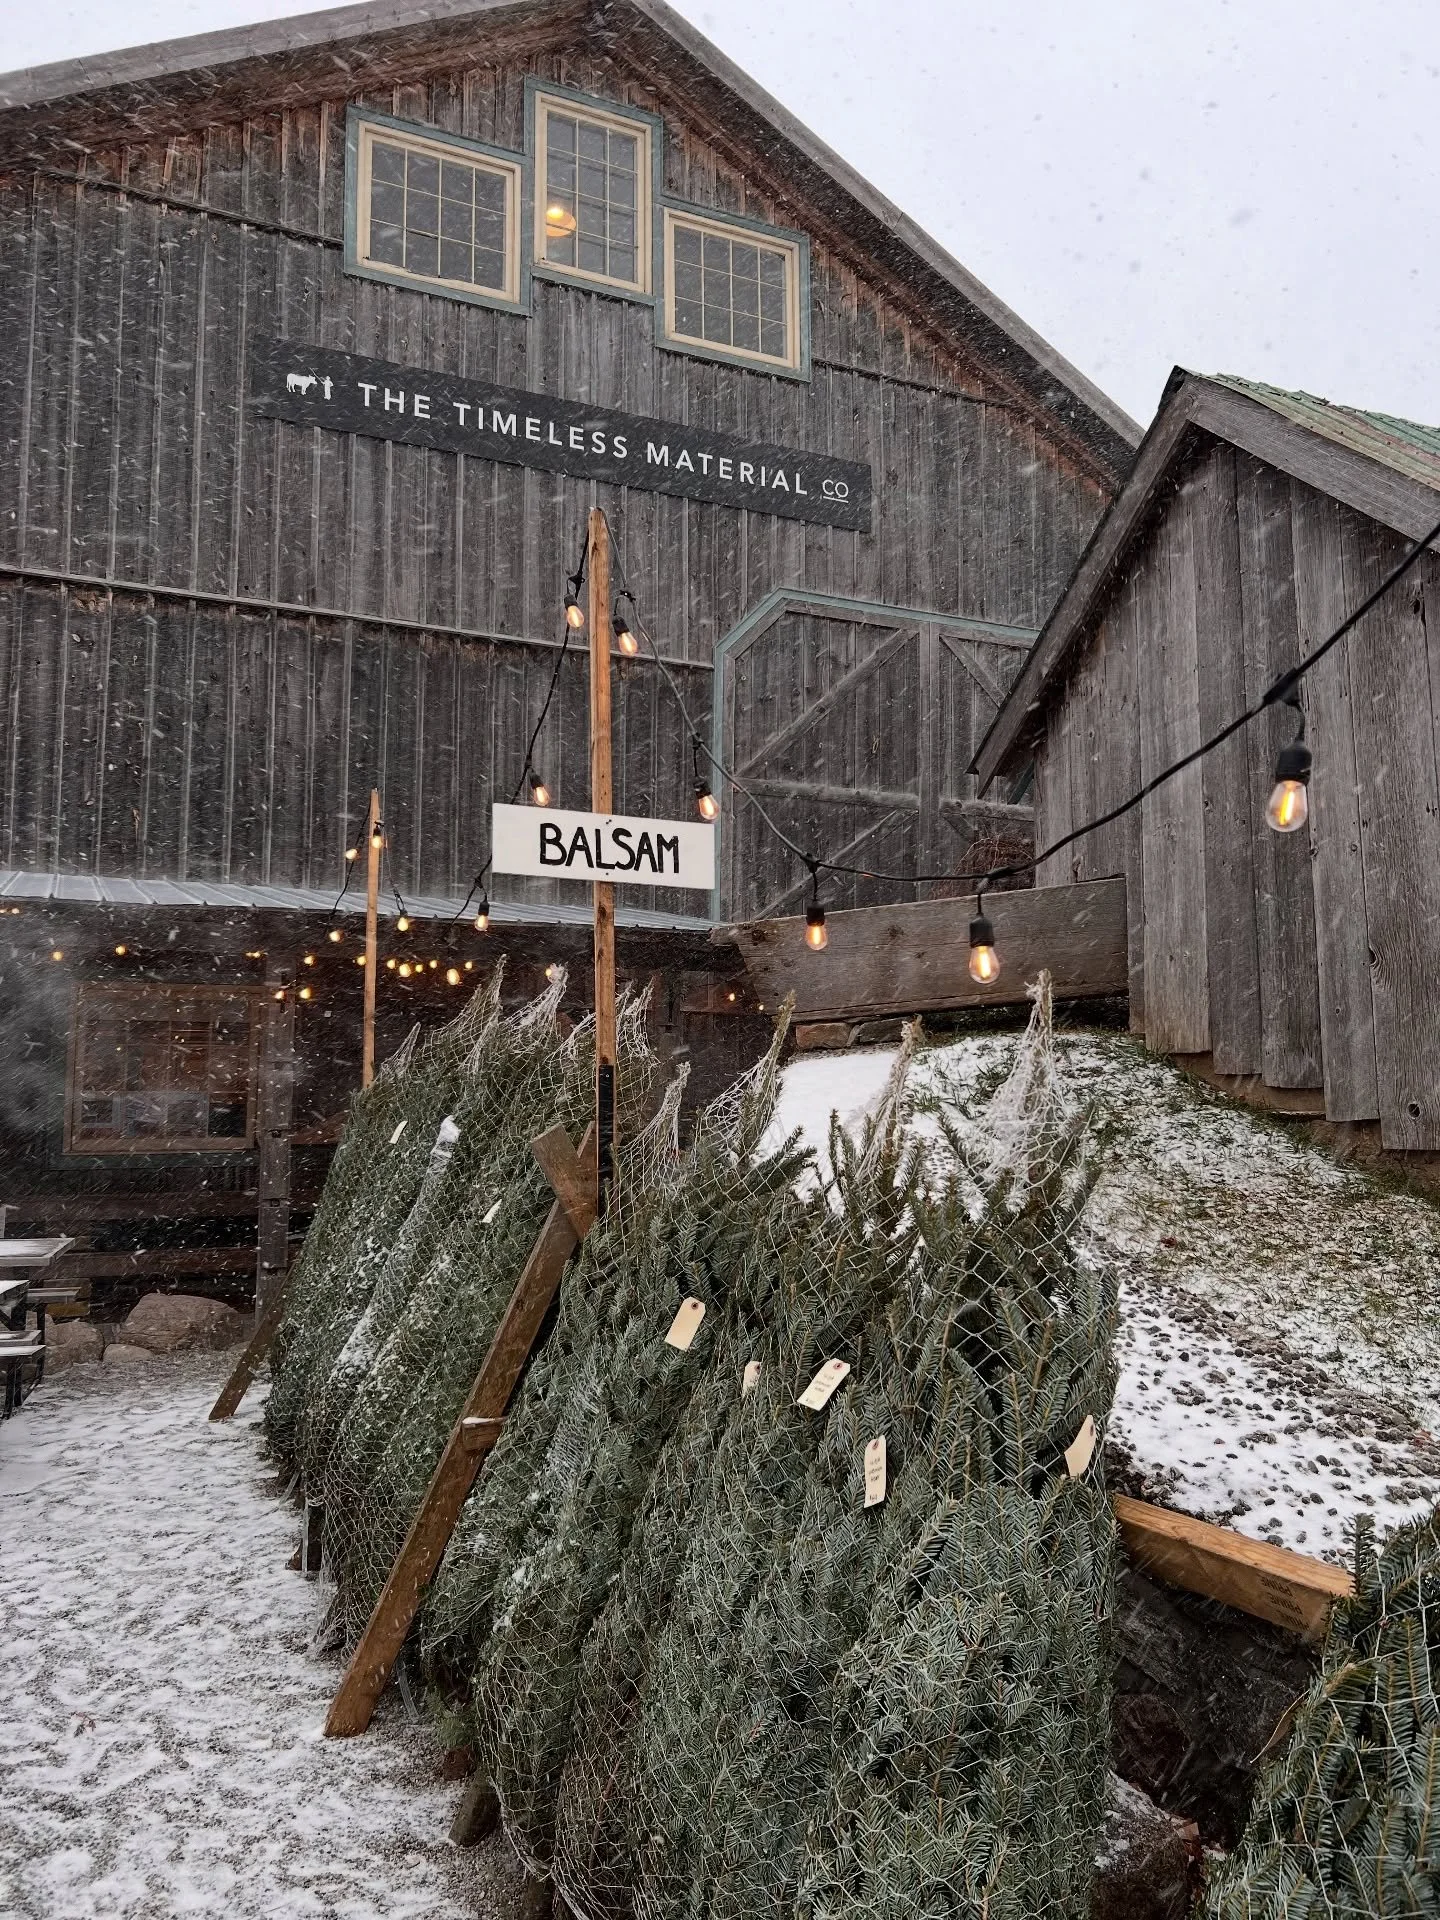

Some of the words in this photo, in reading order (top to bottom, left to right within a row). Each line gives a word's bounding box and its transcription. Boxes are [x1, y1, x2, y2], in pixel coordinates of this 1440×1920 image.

[357, 382, 431, 419] THE
[452, 401, 628, 459] TIMELESS
[647, 441, 808, 496] MATERIAL
[822, 479, 849, 499] CO
[539, 822, 680, 874] BALSAM
